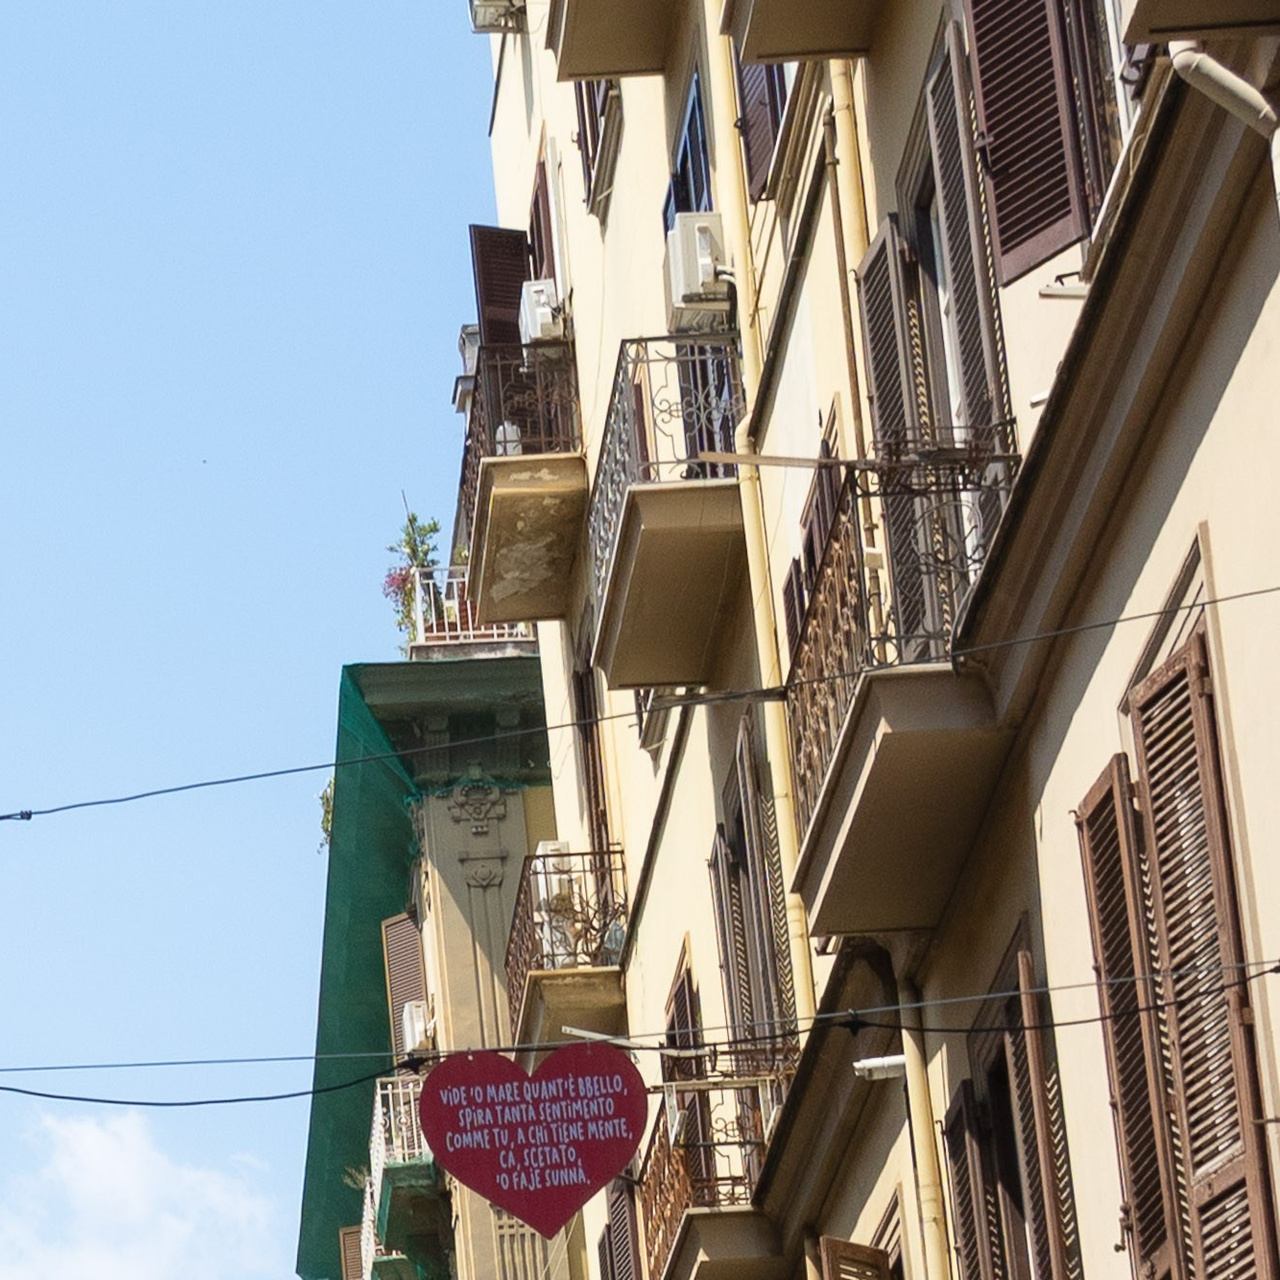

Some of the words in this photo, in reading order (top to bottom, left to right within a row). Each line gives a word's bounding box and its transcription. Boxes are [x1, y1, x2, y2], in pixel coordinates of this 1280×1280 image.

[487, 1081, 520, 1103] MARE
[446, 1128, 490, 1152] COMME
[493, 1126, 514, 1148] TU,
[517, 1127, 525, 1144] A
[588, 1118, 632, 1139] MENTE,
